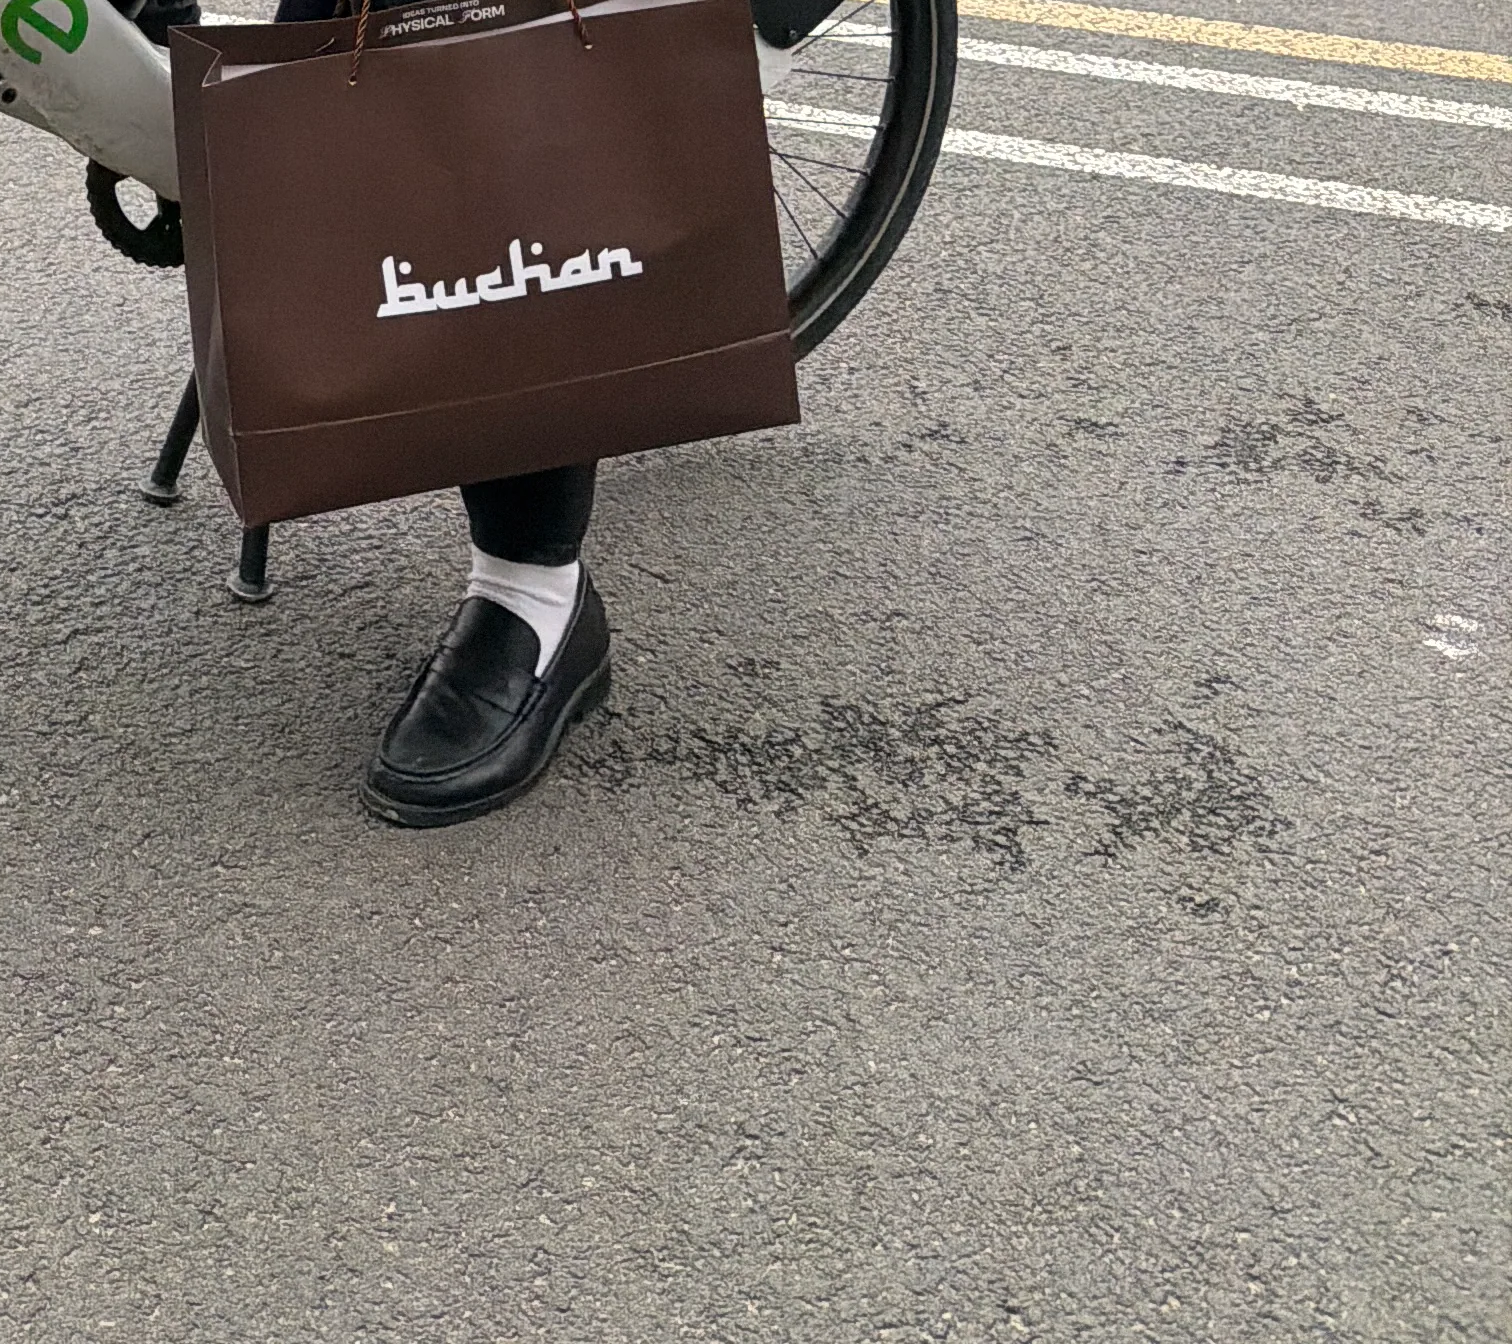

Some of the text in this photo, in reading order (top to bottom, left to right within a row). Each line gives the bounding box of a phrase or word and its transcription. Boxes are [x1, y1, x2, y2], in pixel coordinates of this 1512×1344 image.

[378, 4, 506, 40] PHYSICAL FORM
[402, 0, 480, 19] IDEAS TURNED INTO
[377, 238, 643, 318] buchan
